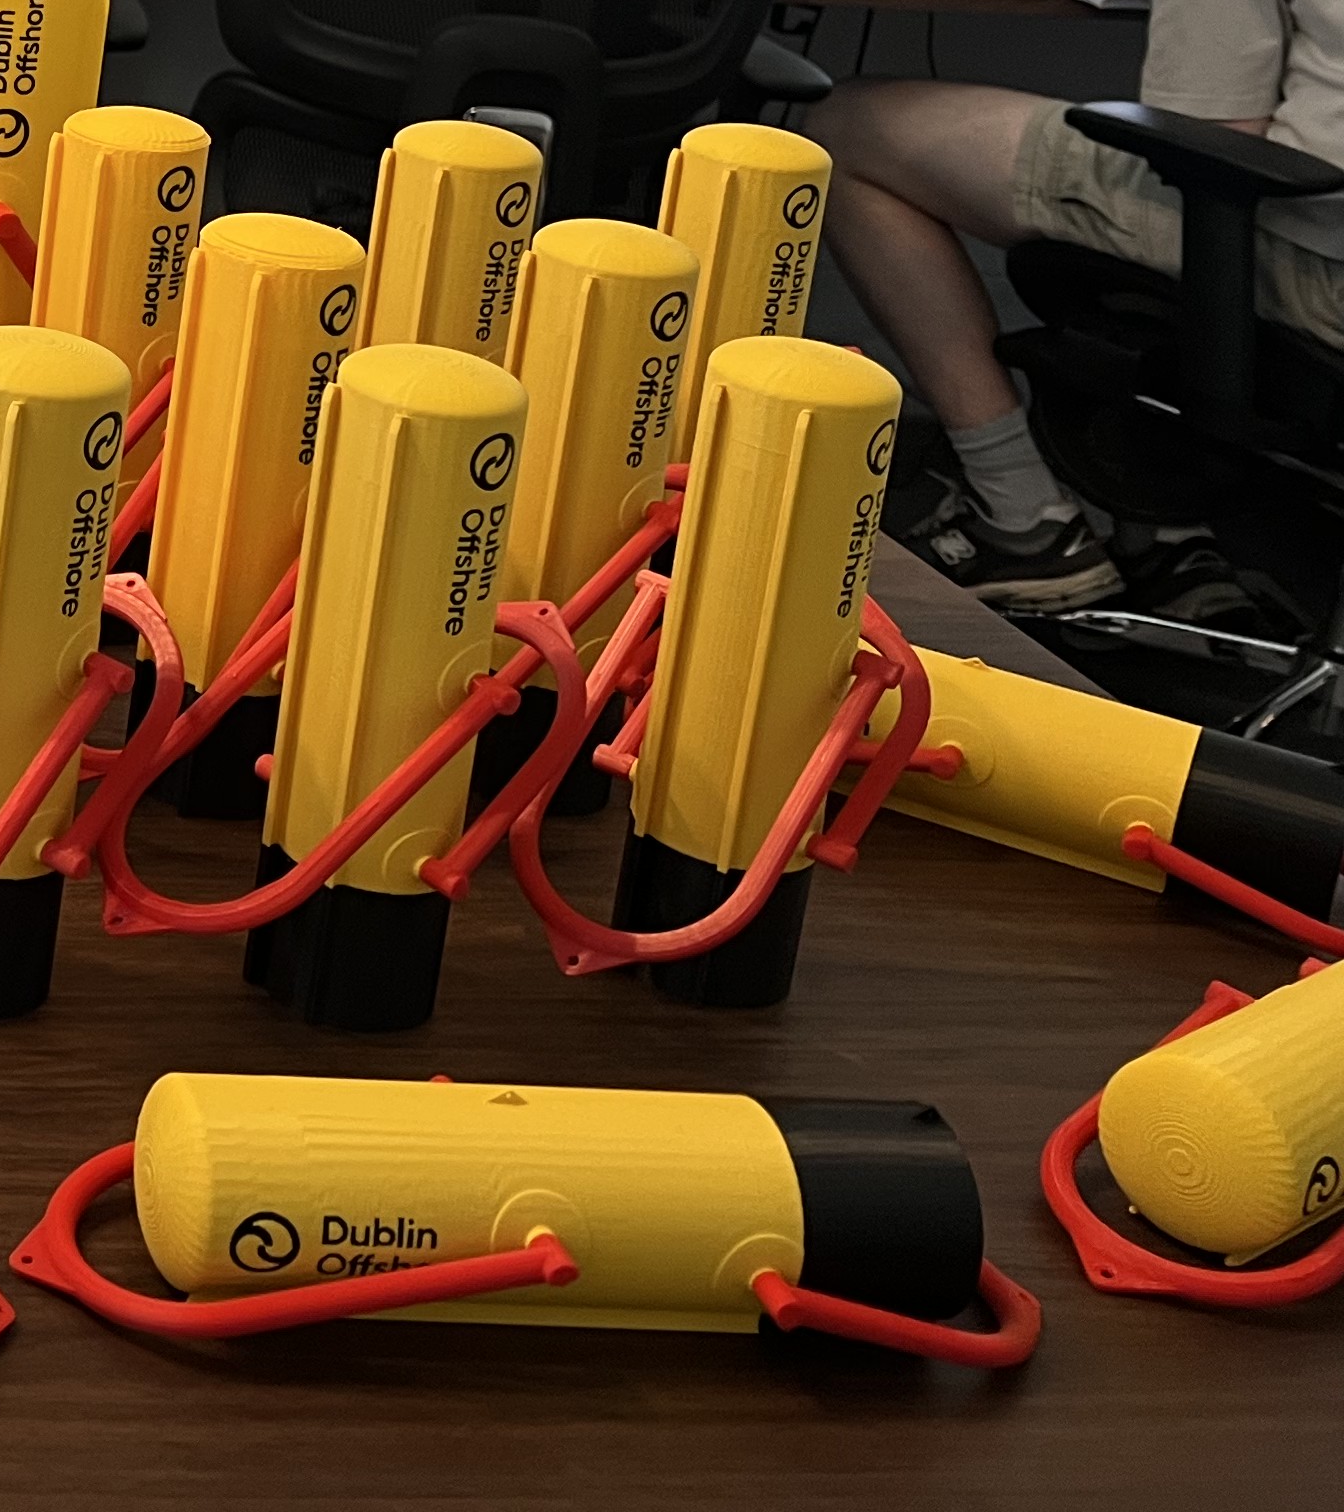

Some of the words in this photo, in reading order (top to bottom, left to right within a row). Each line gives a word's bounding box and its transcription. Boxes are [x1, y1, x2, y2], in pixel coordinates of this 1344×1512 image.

[142, 225, 172, 327] Offshore
[168, 223, 190, 300] Dublin
[476, 241, 507, 342] Offshore
[786, 240, 812, 316] Dublin
[626, 357, 662, 469] Offshore
[653, 354, 680, 439] Dublin
[61, 489, 97, 618] Offshore
[89, 480, 115, 581] Dublin
[444, 508, 485, 636] Offshore
[476, 503, 507, 601] Dublin
[836, 494, 874, 619] Offshore
[321, 1215, 438, 1249] Dublin
